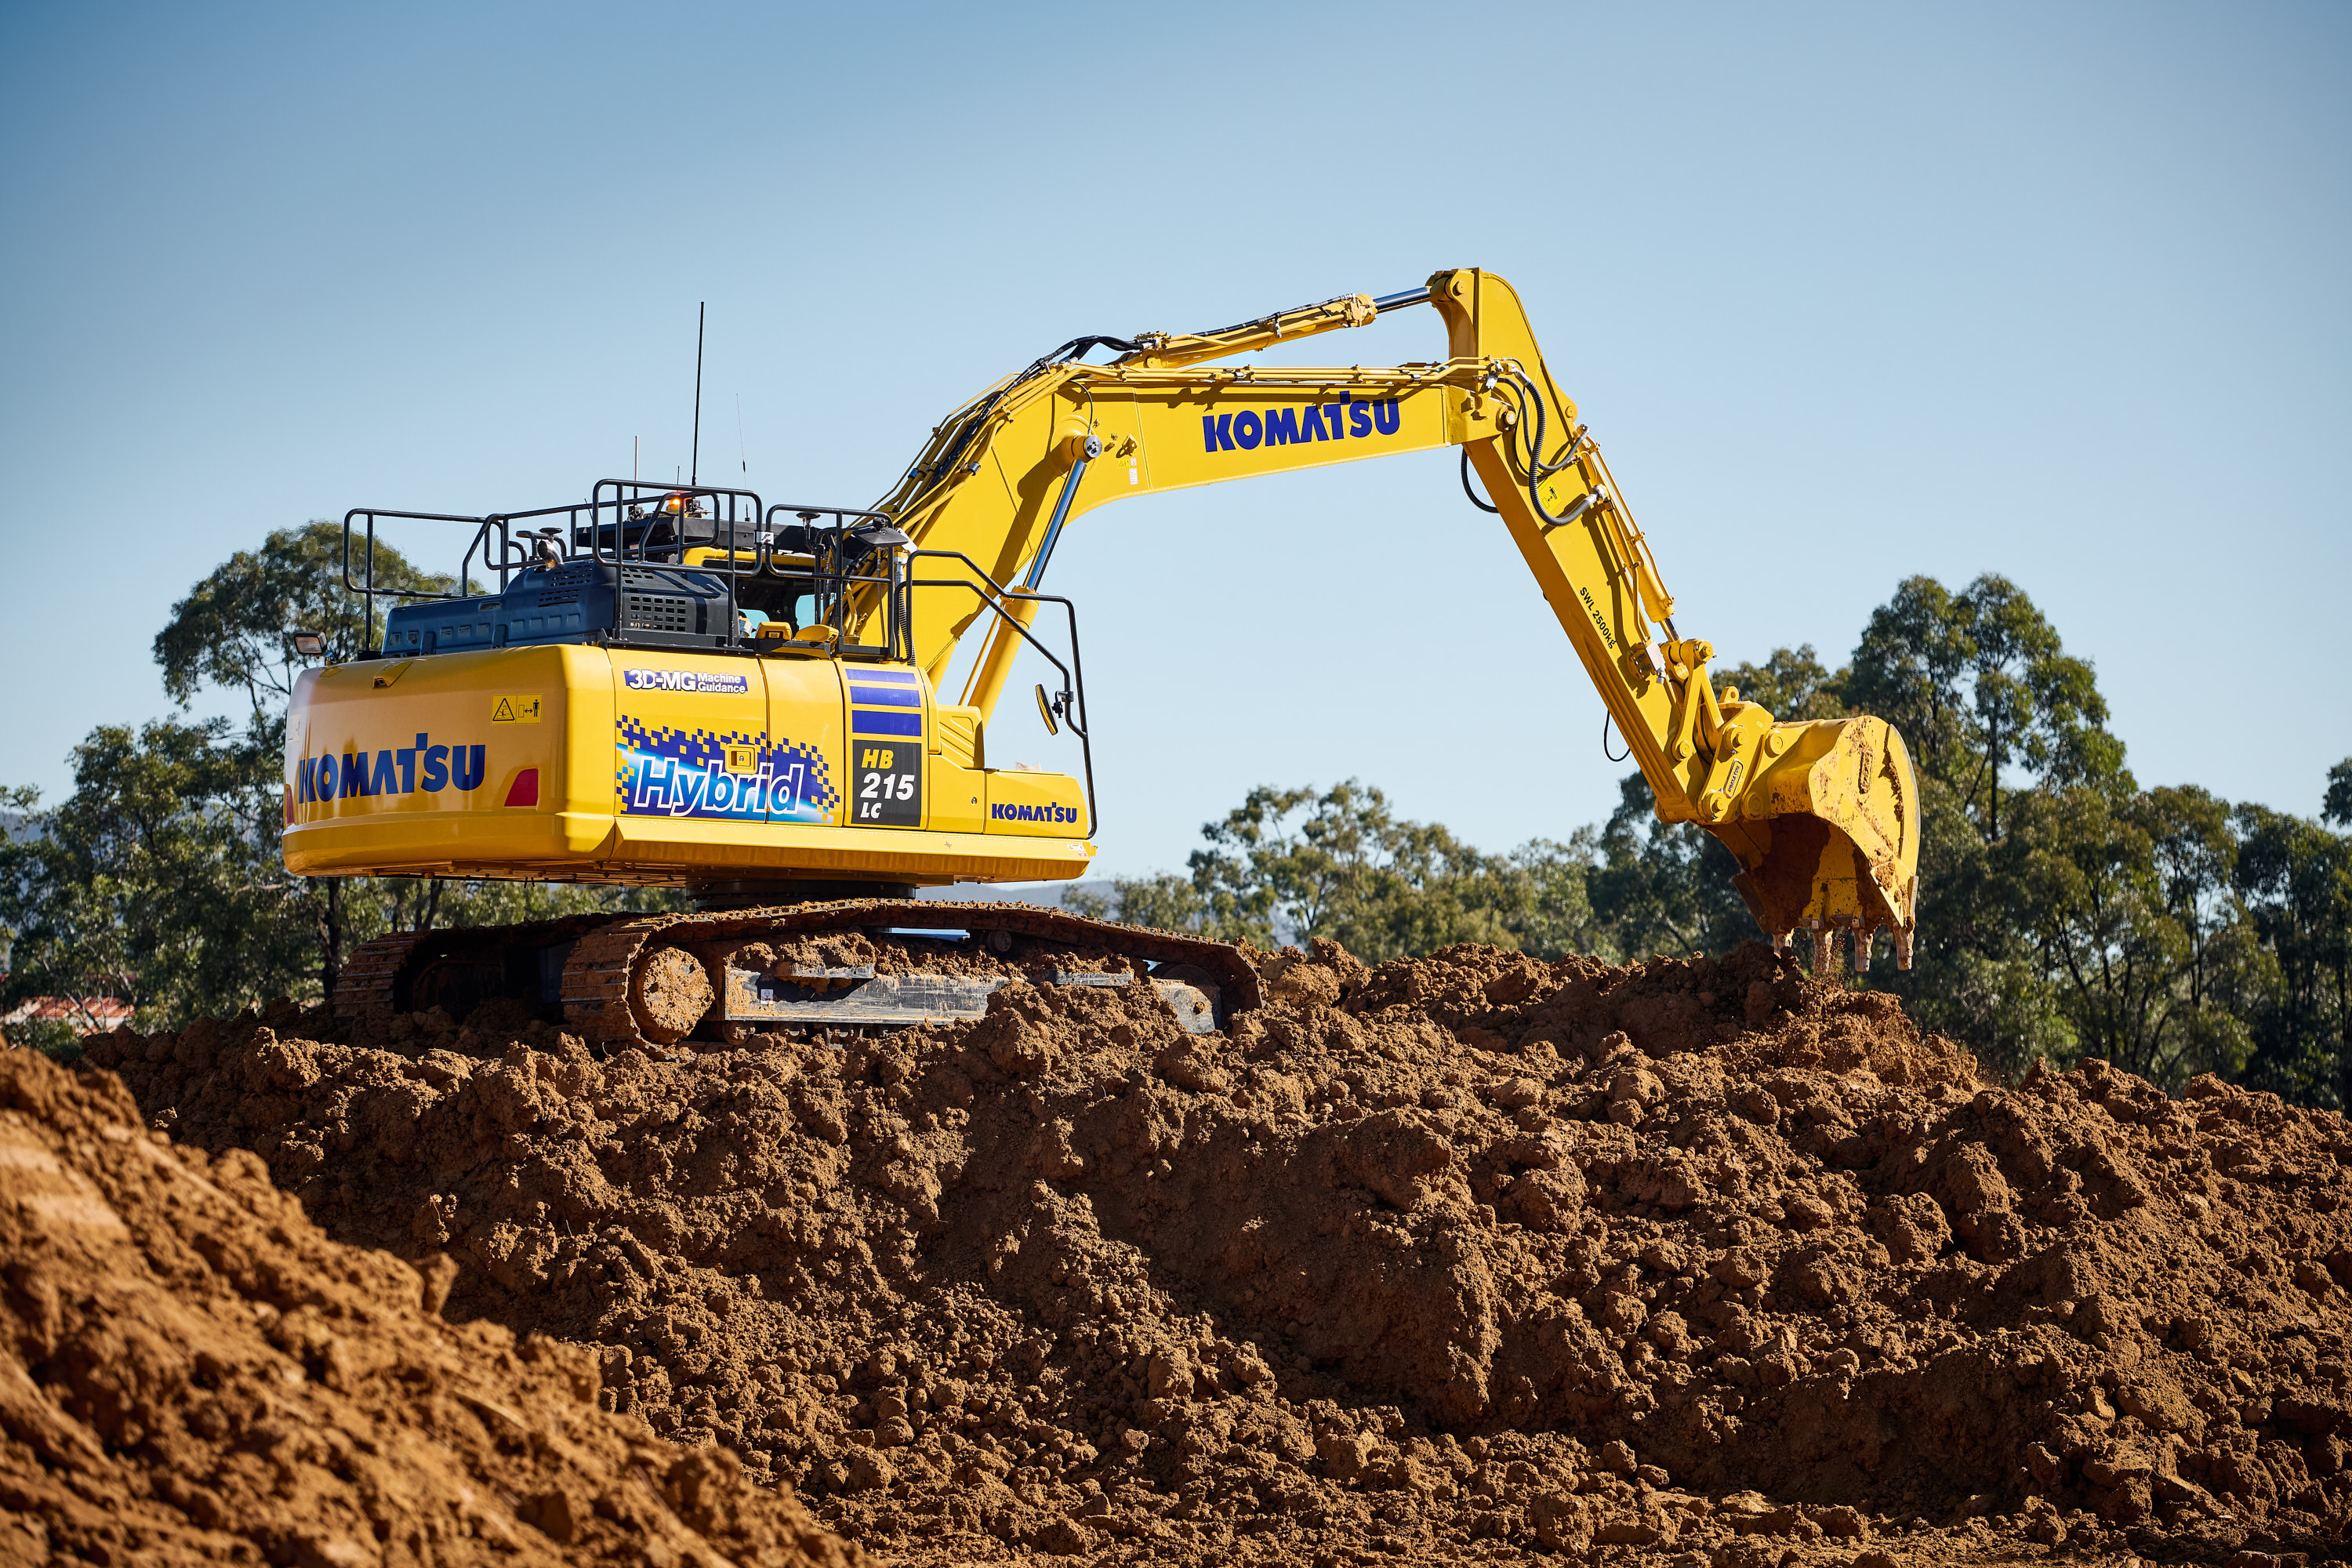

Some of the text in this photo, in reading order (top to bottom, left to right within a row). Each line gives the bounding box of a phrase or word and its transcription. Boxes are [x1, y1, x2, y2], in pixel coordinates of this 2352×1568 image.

[1202, 390, 1401, 452] KOMATSU
[1580, 586, 1617, 649] SWL 2500kg
[629, 668, 697, 691] 3D-MG
[697, 672, 742, 684] Machine
[697, 683, 746, 694] Guidance
[299, 732, 485, 804] KOMATSU
[861, 749, 894, 768] HB
[633, 756, 804, 817] Hybrid
[860, 772, 916, 800] 215
[860, 802, 882, 819] LC
[992, 801, 1077, 823] KOMATSU
